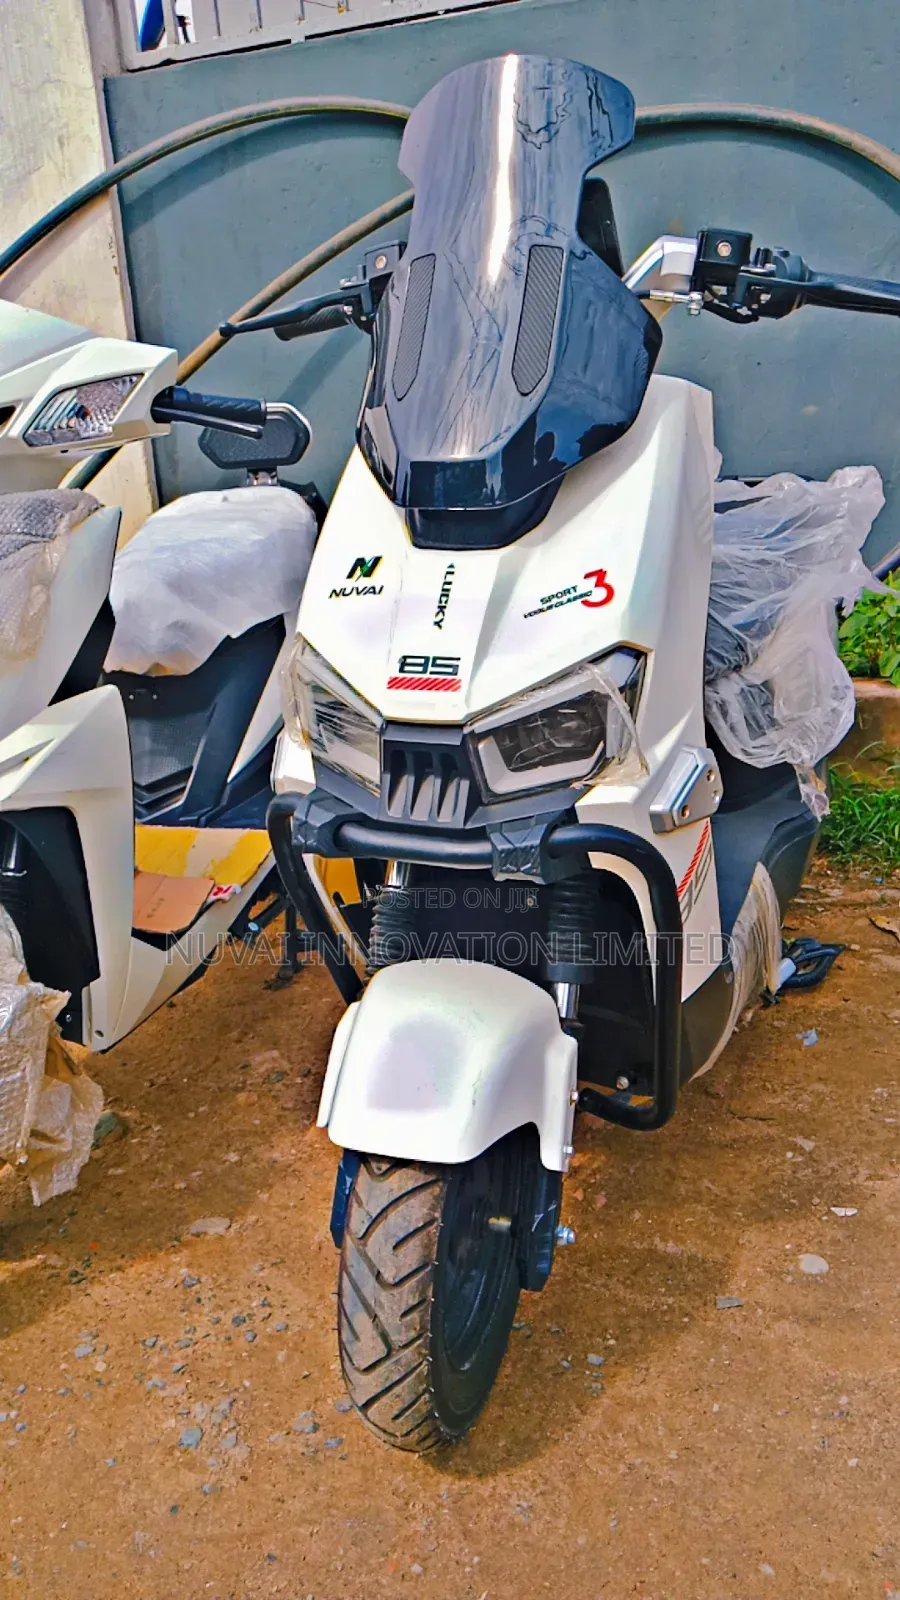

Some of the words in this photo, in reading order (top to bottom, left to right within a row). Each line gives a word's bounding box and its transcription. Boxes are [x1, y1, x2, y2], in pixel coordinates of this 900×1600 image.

[328, 585, 384, 599] NUVAI
[540, 585, 578, 605] SPORT
[581, 568, 615, 608] 3
[433, 571, 455, 630] LUCKY
[399, 655, 461, 676] 85
